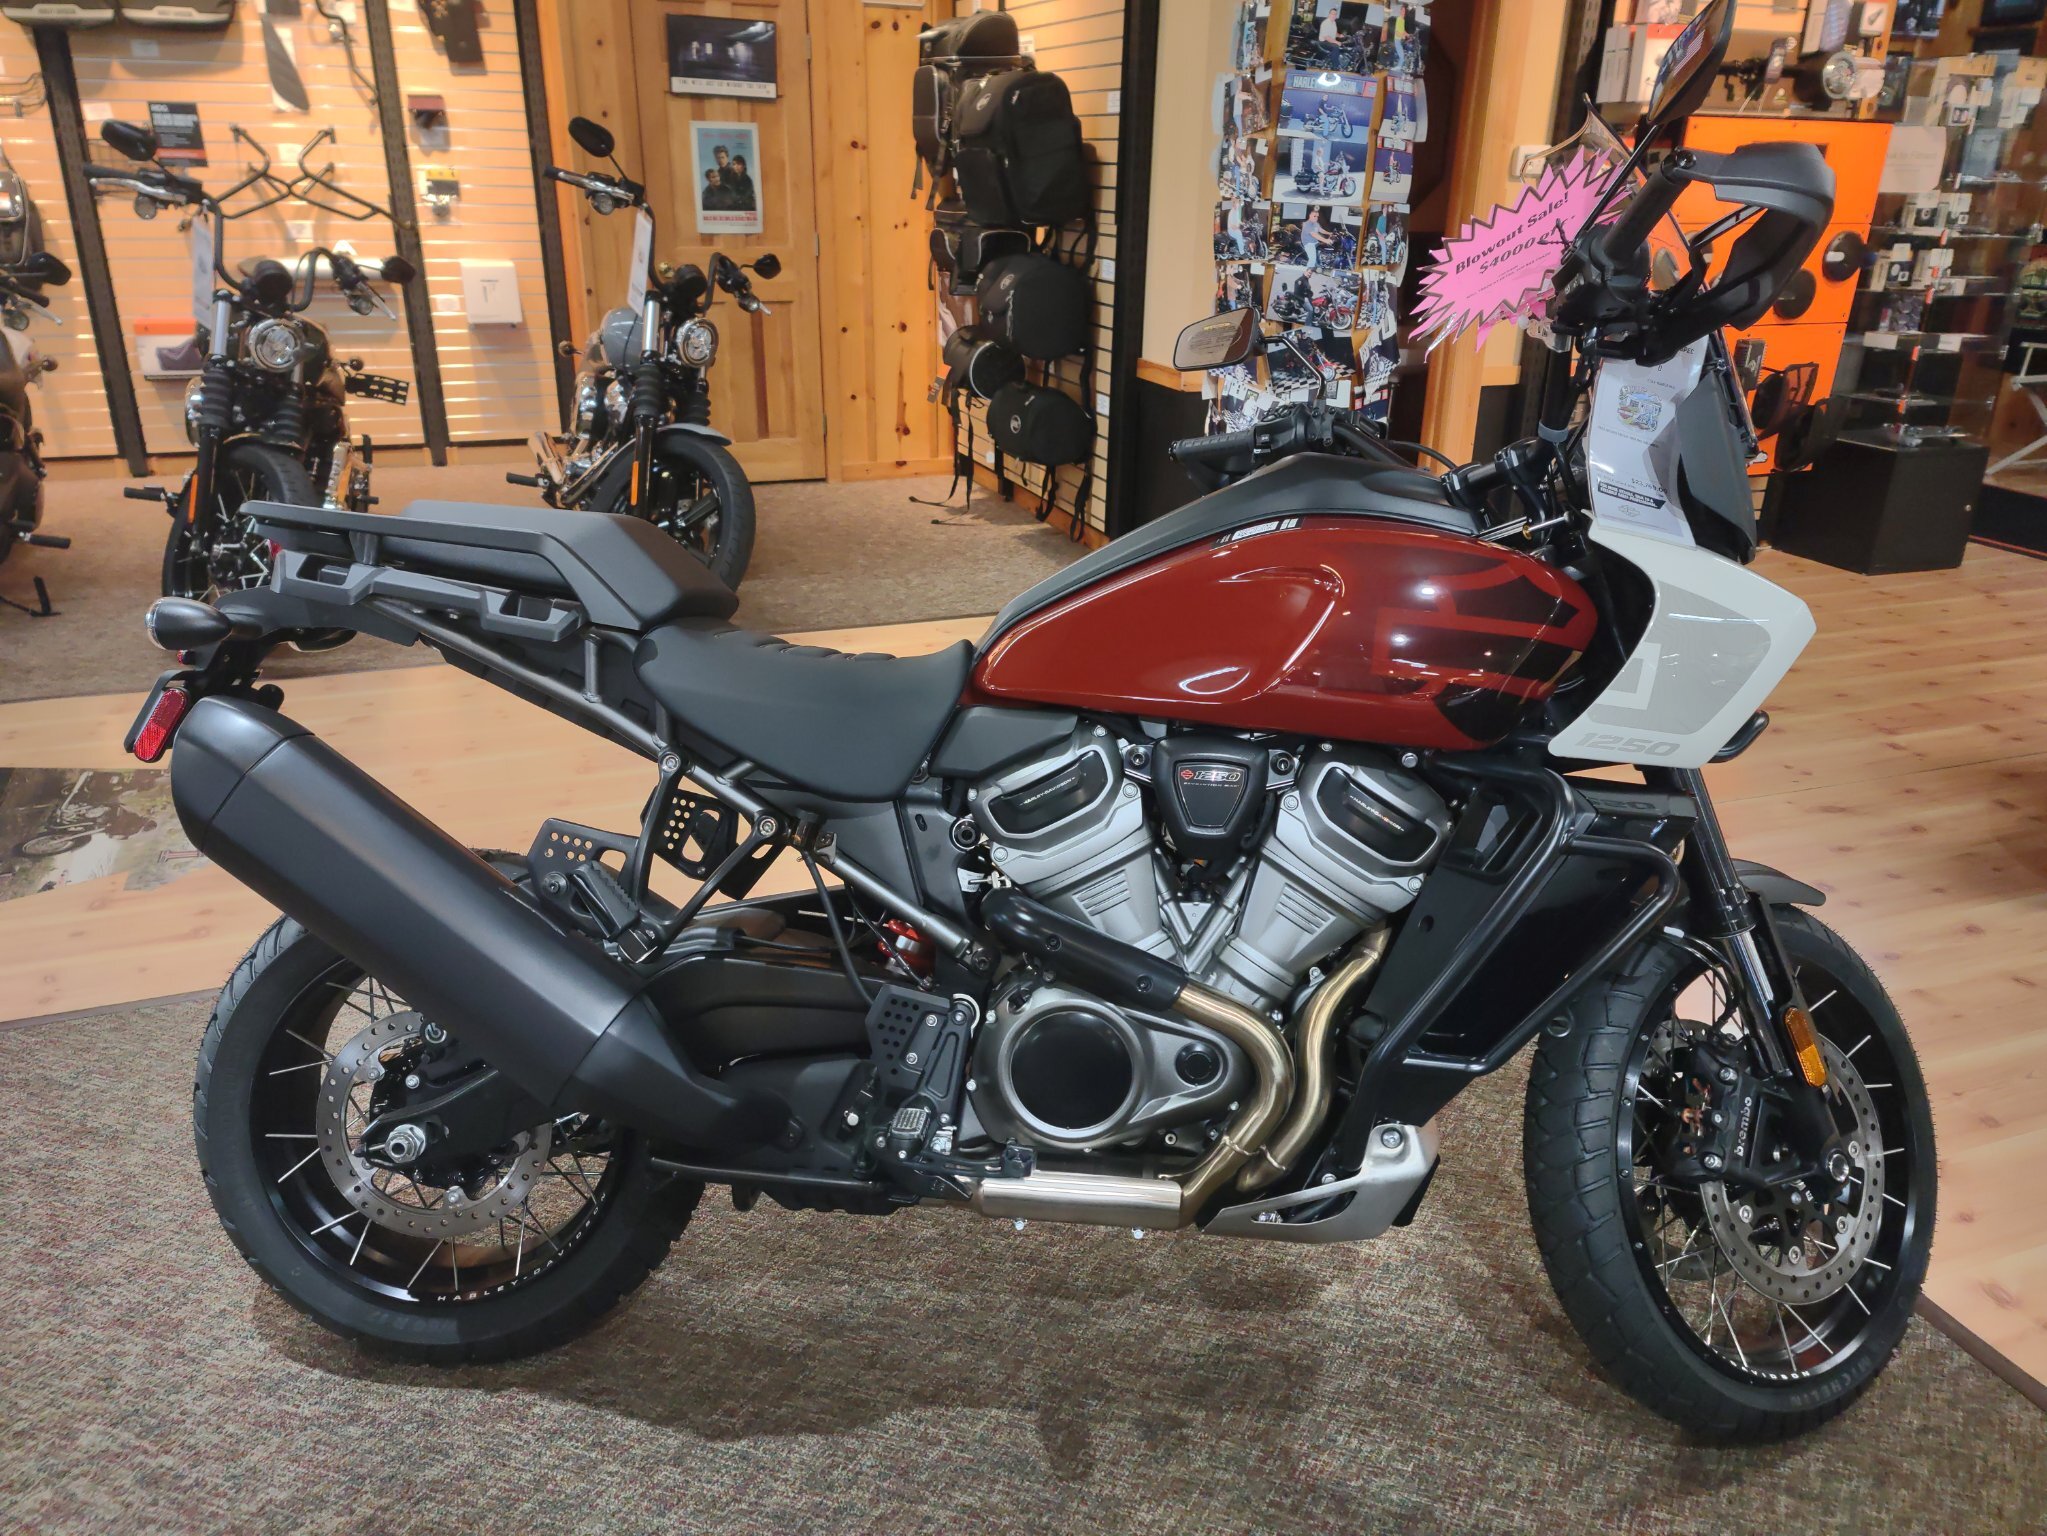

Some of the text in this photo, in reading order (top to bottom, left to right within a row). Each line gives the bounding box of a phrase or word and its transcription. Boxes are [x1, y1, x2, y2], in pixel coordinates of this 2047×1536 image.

[1455, 191, 1569, 275] Blowout Sale!
[1479, 236, 1538, 275] $4000
[1575, 732, 1681, 757] 1250
[1733, 1096, 1753, 1157] brembo
[437, 1191, 607, 1302] HARLEY-DAVIDSON
[1790, 1356, 1872, 1406] MICHELIN
